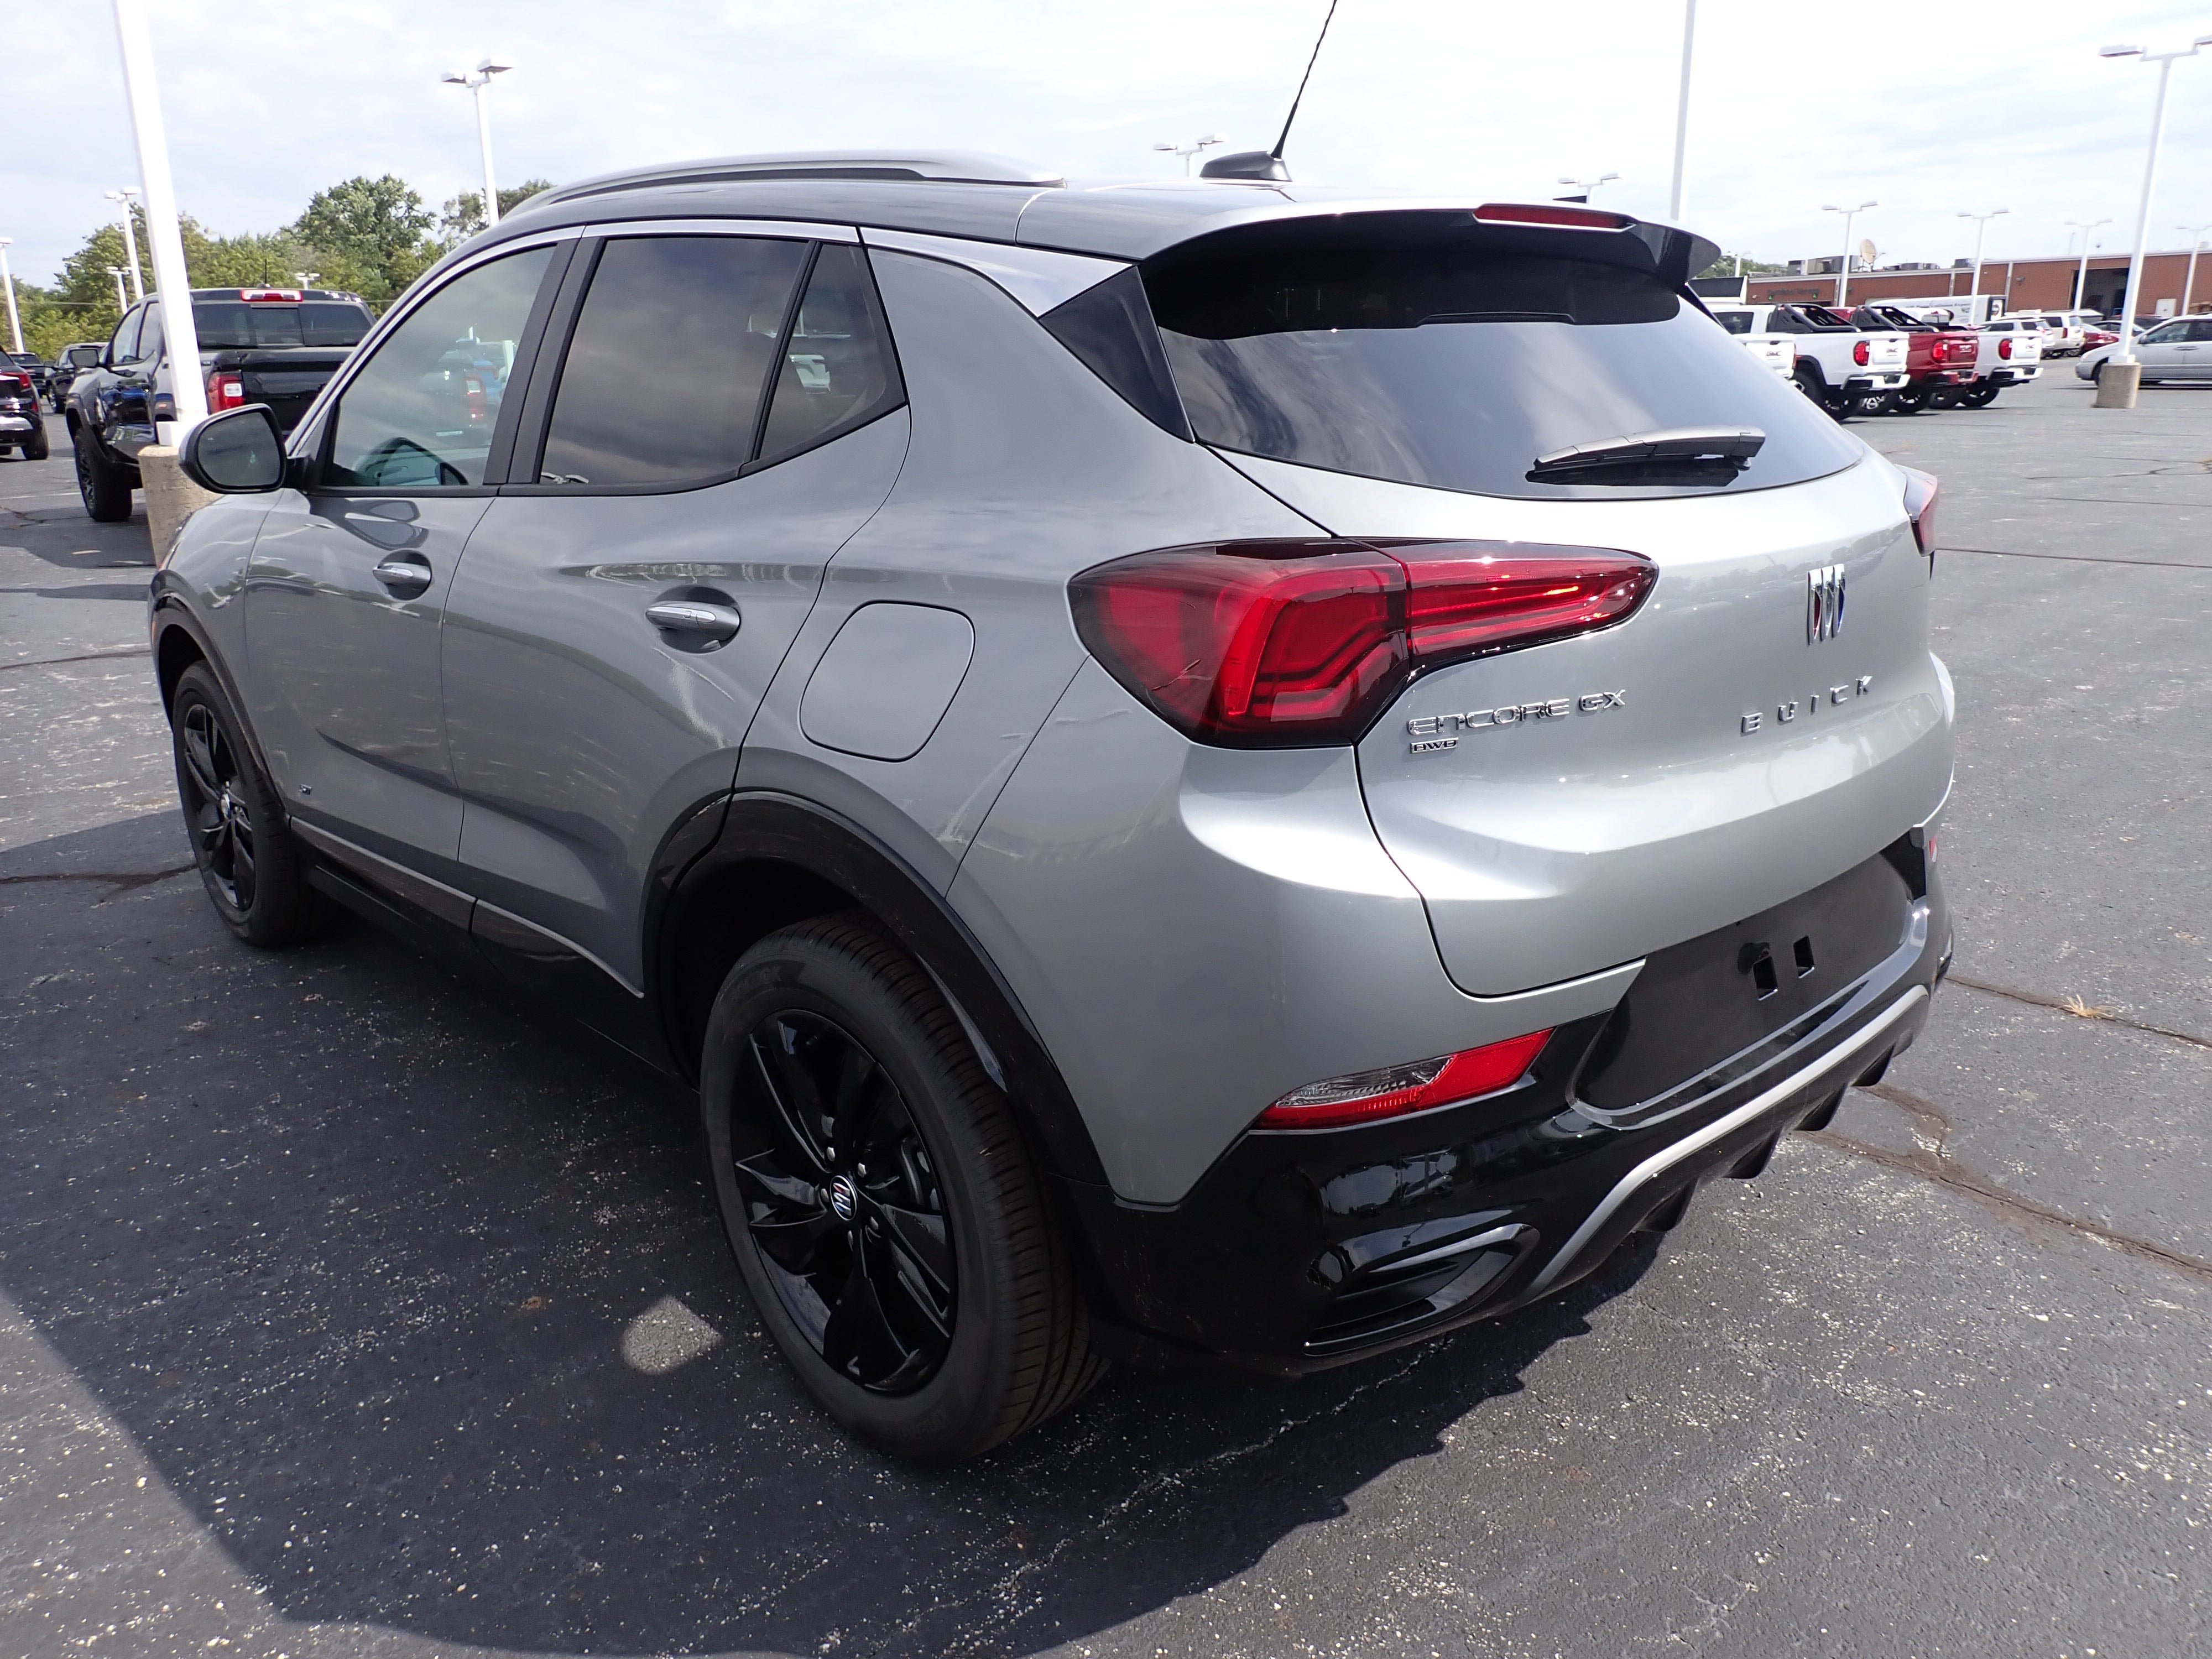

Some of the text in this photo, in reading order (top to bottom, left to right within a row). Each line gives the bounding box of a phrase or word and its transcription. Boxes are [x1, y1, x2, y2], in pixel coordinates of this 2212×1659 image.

[1407, 689, 1626, 736] ENCORE GX
[1741, 676, 1872, 735] BUICK
[1411, 738, 1458, 753] AWD
